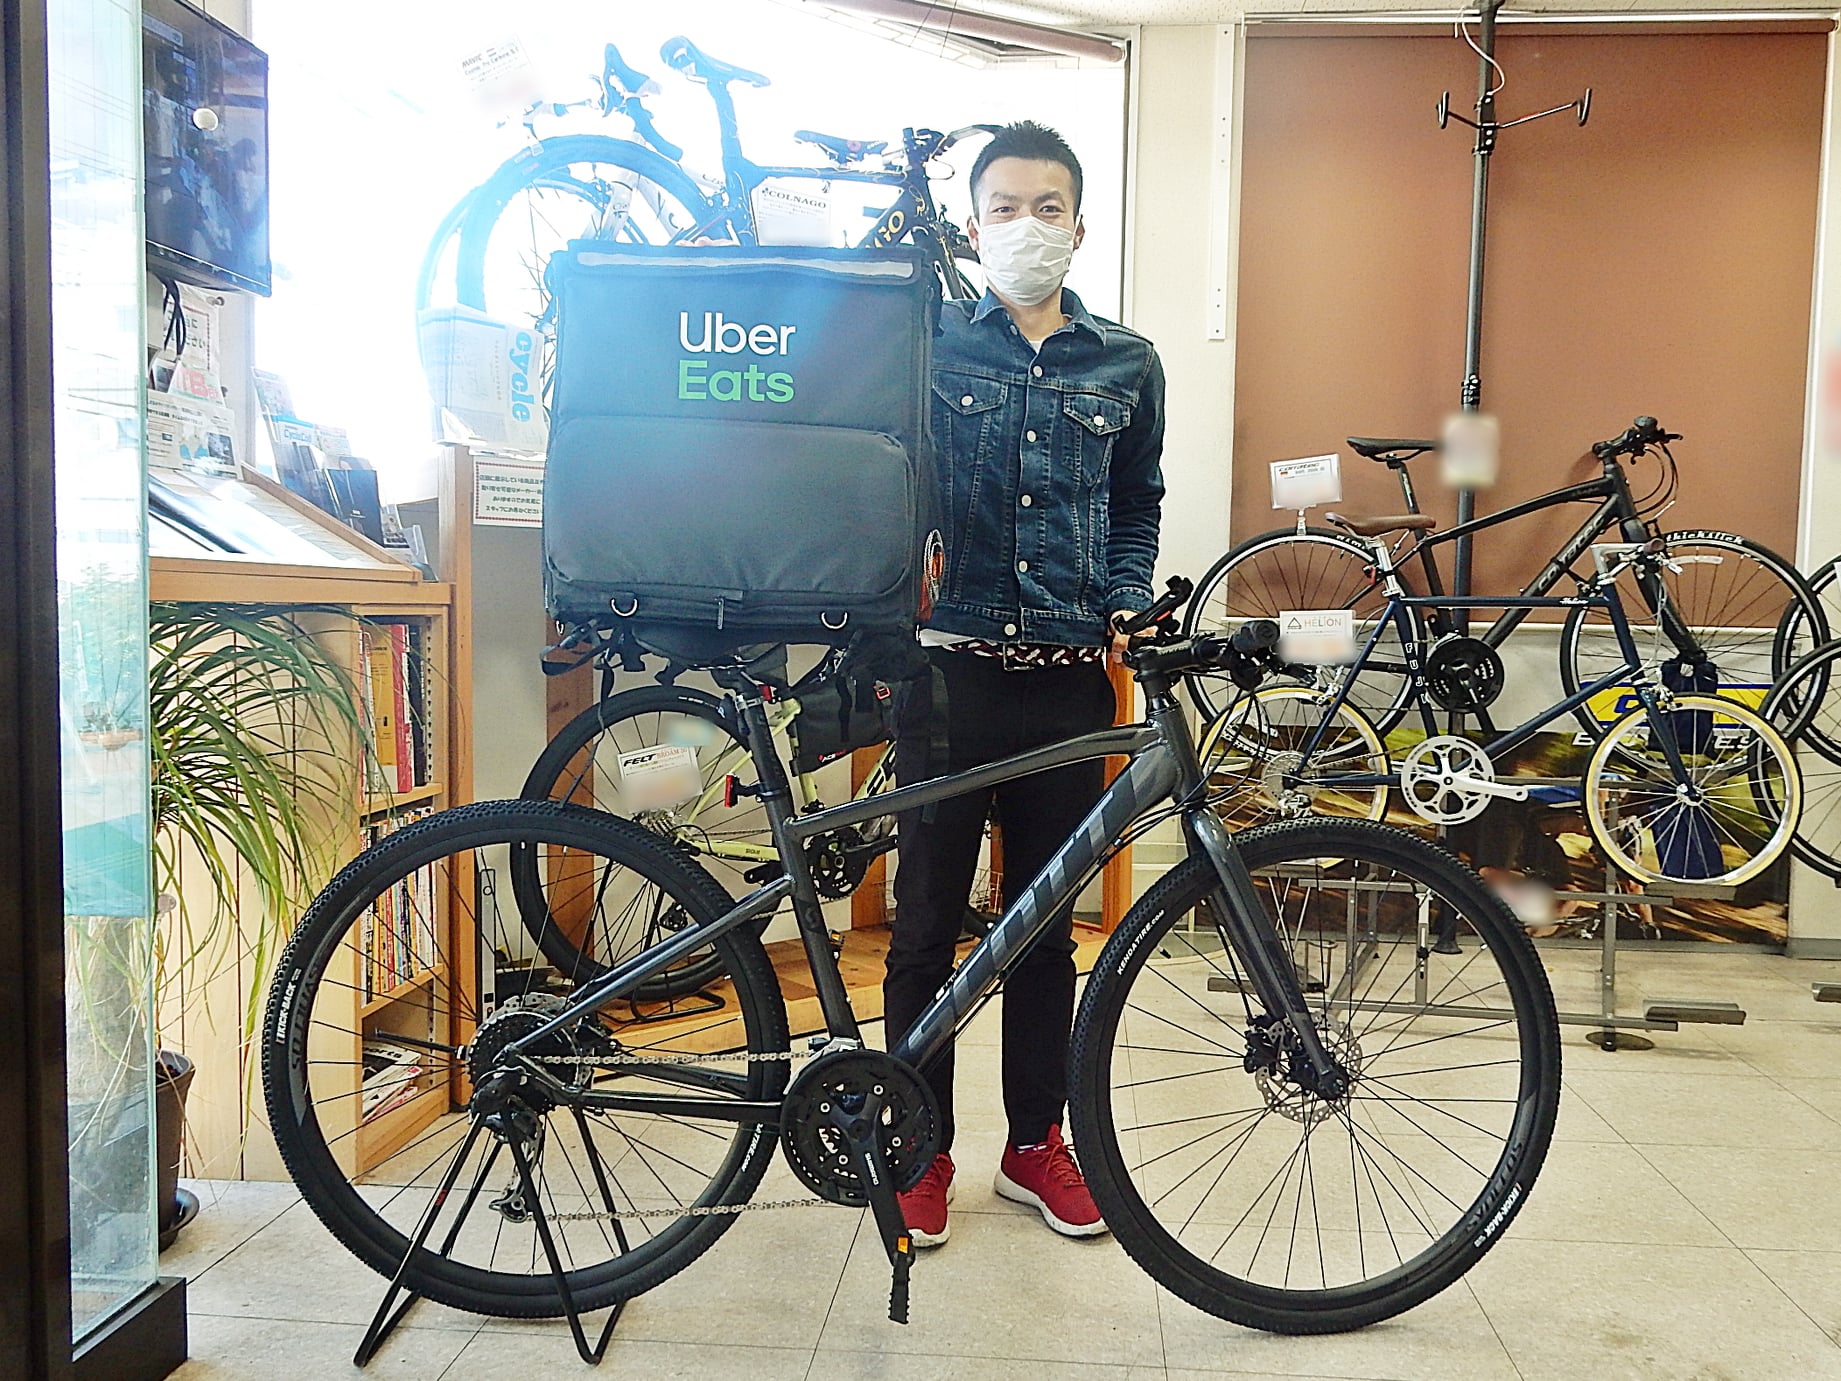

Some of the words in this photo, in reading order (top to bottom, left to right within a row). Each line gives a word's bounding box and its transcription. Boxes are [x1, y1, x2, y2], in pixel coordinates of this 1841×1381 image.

[768, 189, 827, 209] COLNAGO
[680, 311, 797, 355] Uber
[509, 332, 534, 422] cycle
[678, 359, 795, 403] Eats
[623, 753, 656, 767] FELT
[906, 789, 1113, 1060] SCOTT
